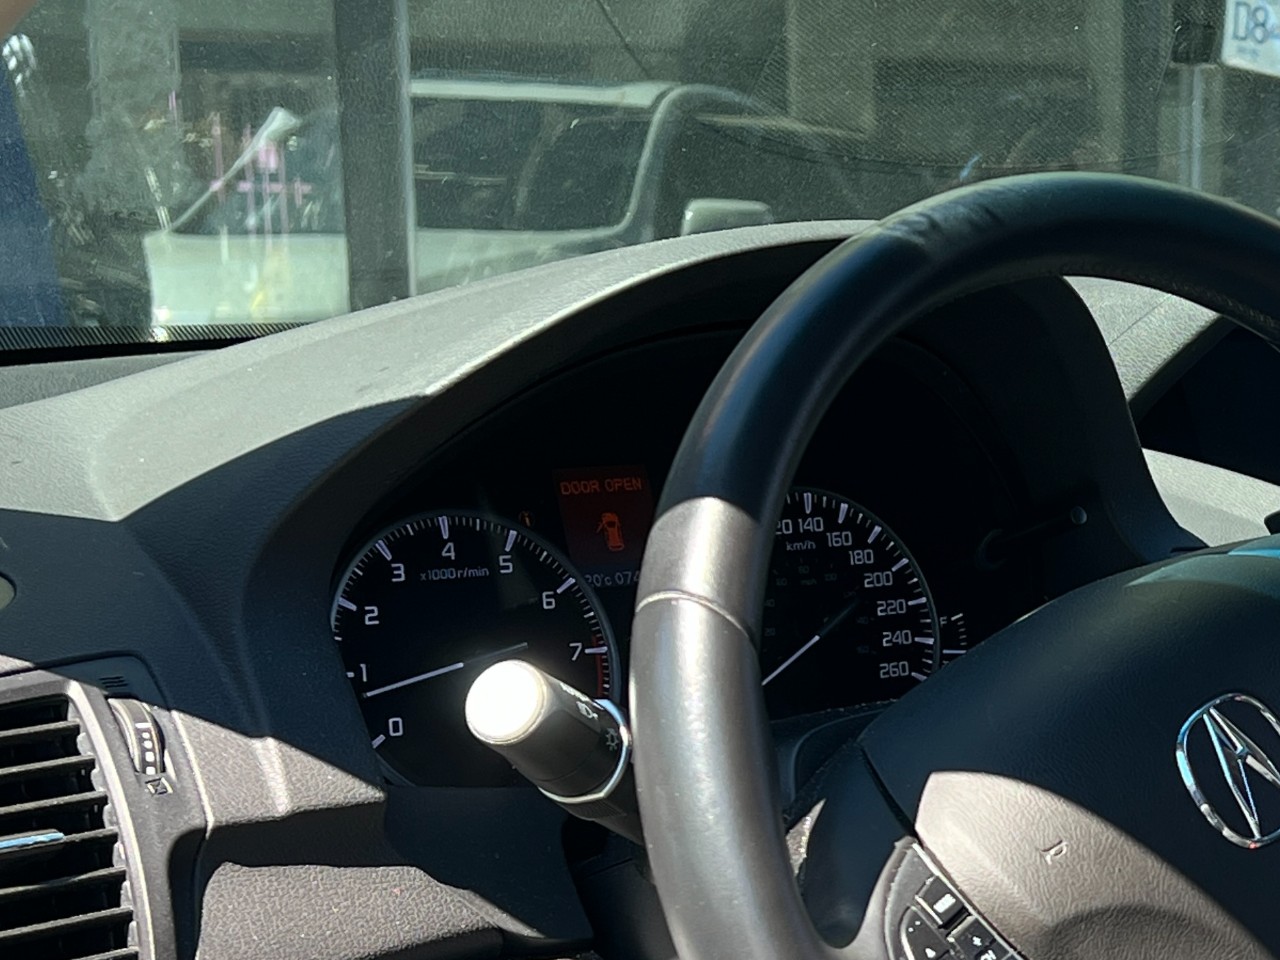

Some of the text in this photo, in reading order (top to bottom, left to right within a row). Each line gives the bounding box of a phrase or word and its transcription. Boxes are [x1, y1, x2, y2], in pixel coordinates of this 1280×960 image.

[561, 478, 642, 496] DOOR OPEN
[798, 517, 824, 533] 140
[786, 540, 816, 551] km/h
[827, 531, 852, 548] 160
[441, 543, 456, 560] 4
[849, 550, 874, 566] 180
[391, 564, 406, 582] 3
[499, 556, 514, 573] 5
[864, 571, 893, 588] 200
[542, 591, 556, 609] 6
[877, 599, 906, 616] 220
[365, 606, 380, 625] 2
[940, 616, 948, 628] F
[883, 630, 912, 647] 240
[569, 642, 583, 661] 7
[360, 664, 367, 682] 1
[880, 661, 909, 679] 260
[388, 717, 403, 736] 0
